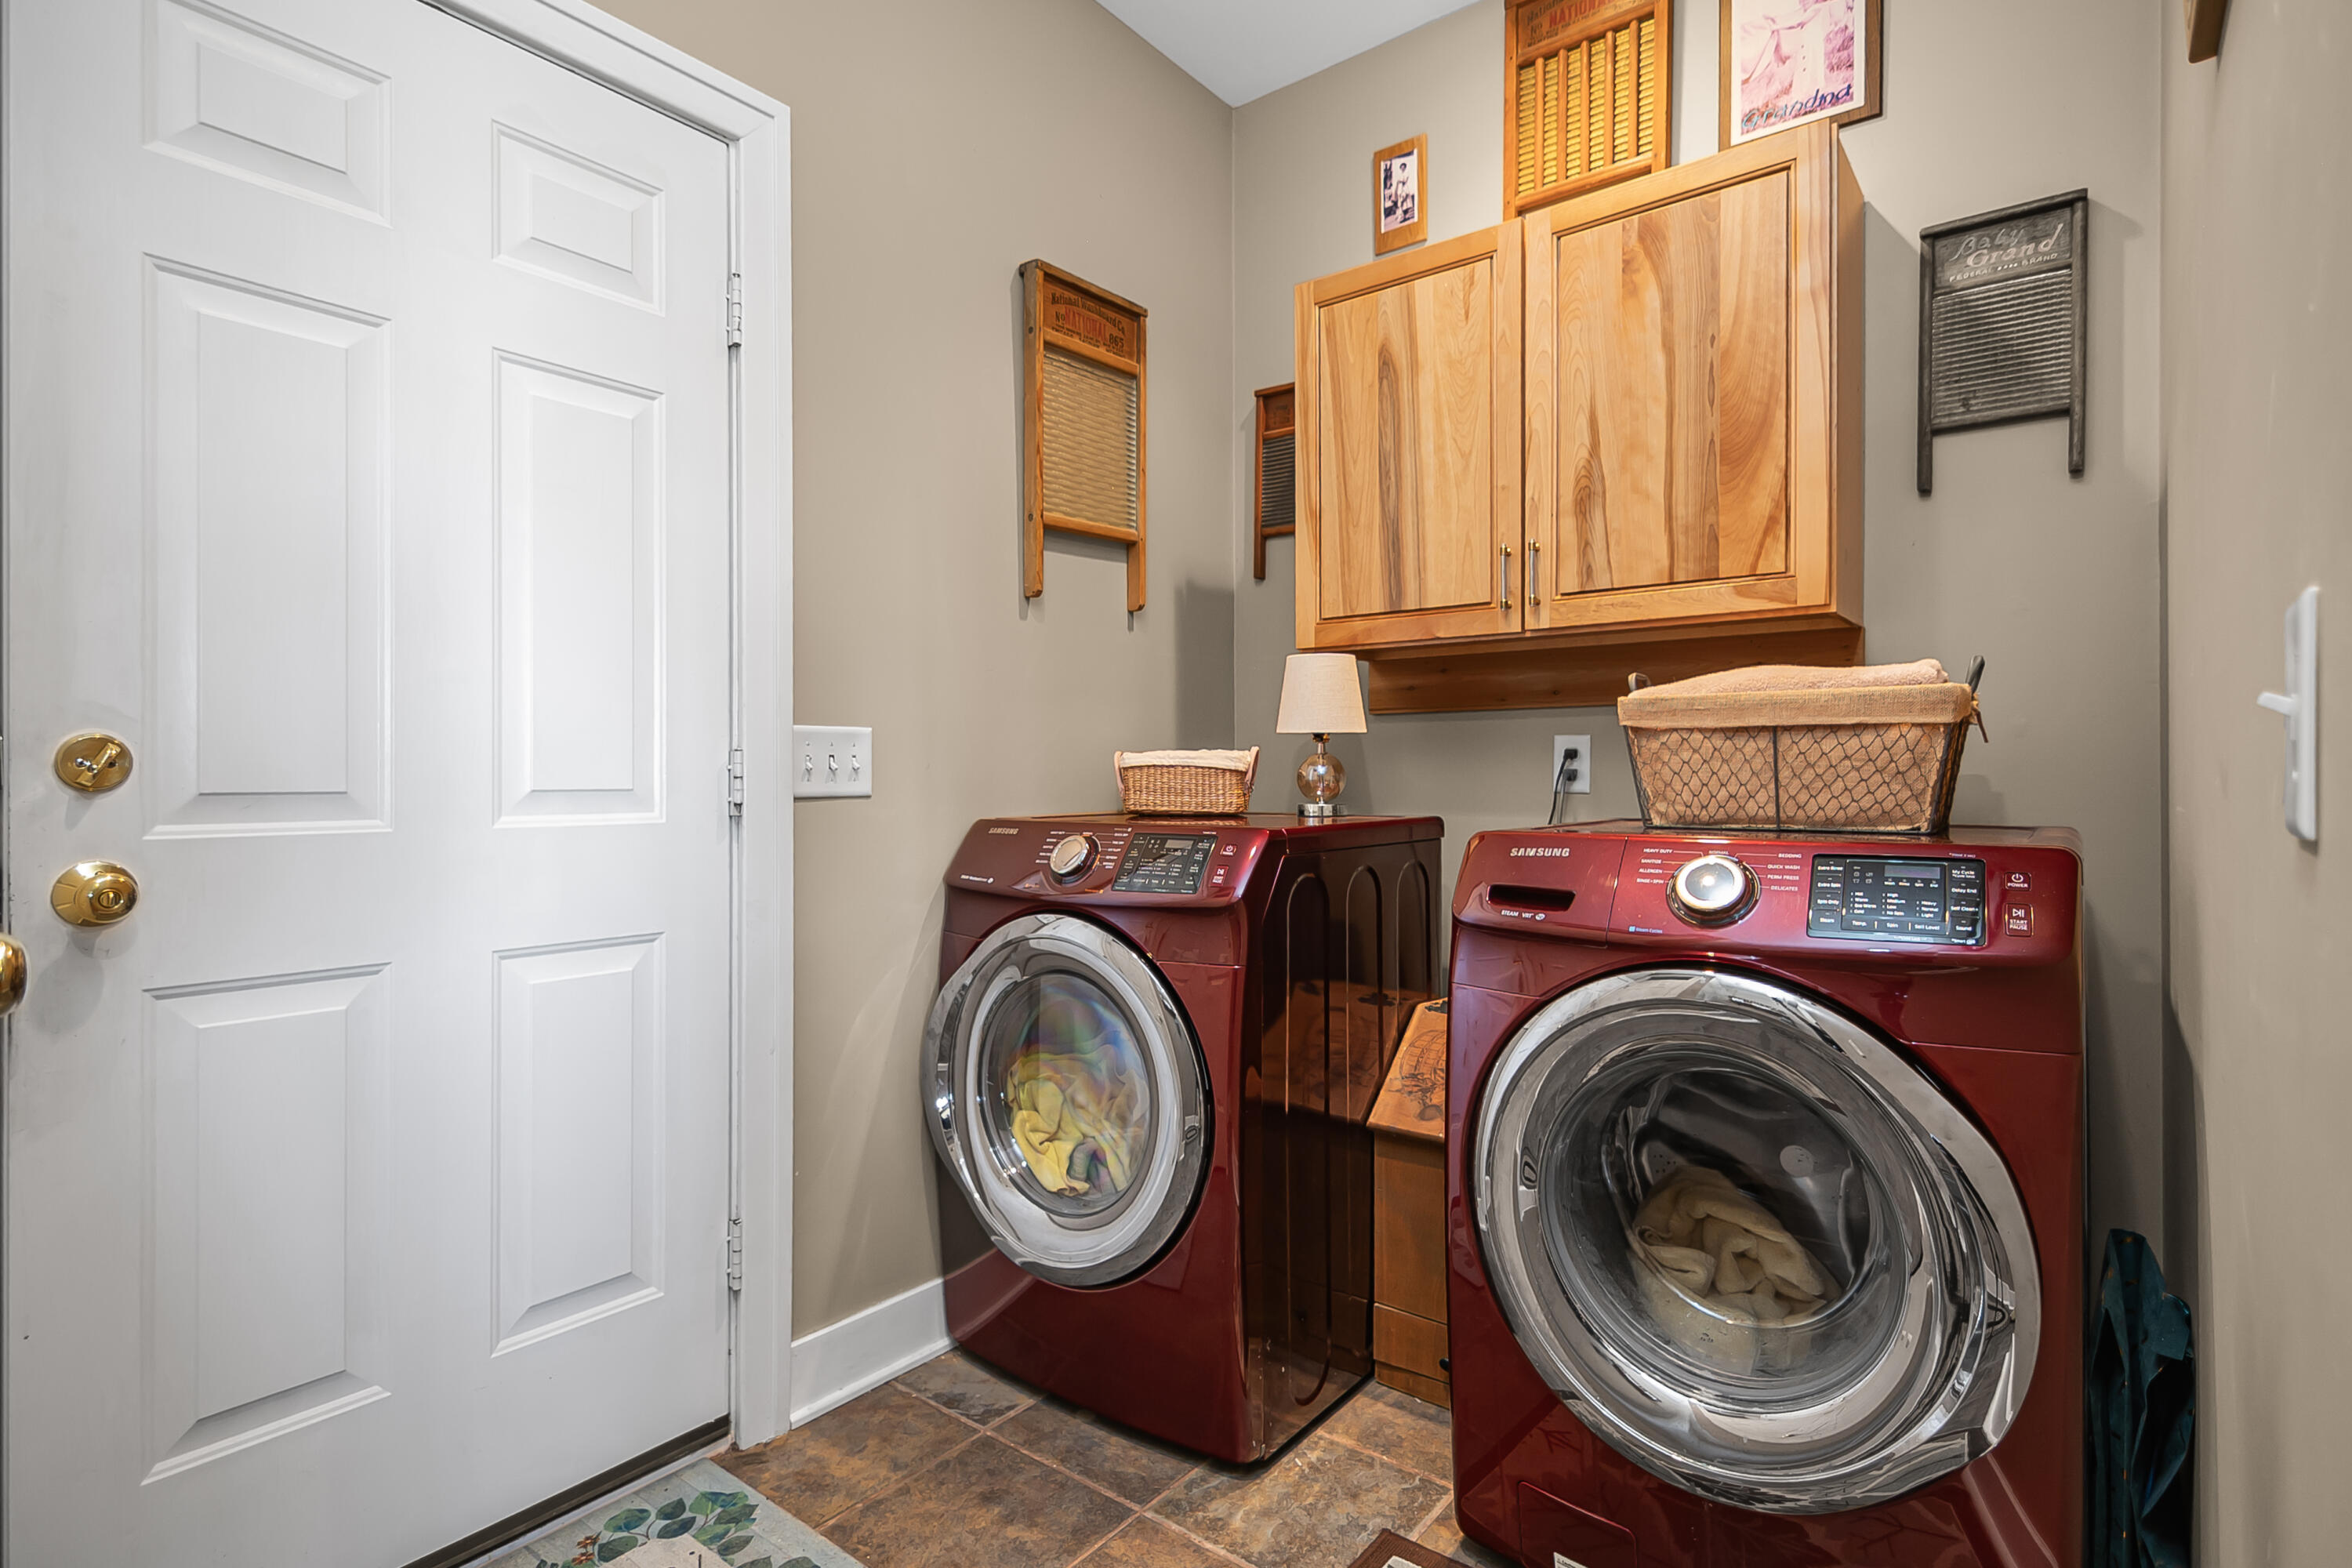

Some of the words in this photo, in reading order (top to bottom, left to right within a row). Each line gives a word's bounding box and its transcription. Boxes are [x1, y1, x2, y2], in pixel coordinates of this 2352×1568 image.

[1741, 83, 1853, 129] Grandma
[1965, 223, 2063, 268] Grand
[1510, 848, 1570, 857] SAMSUNG
